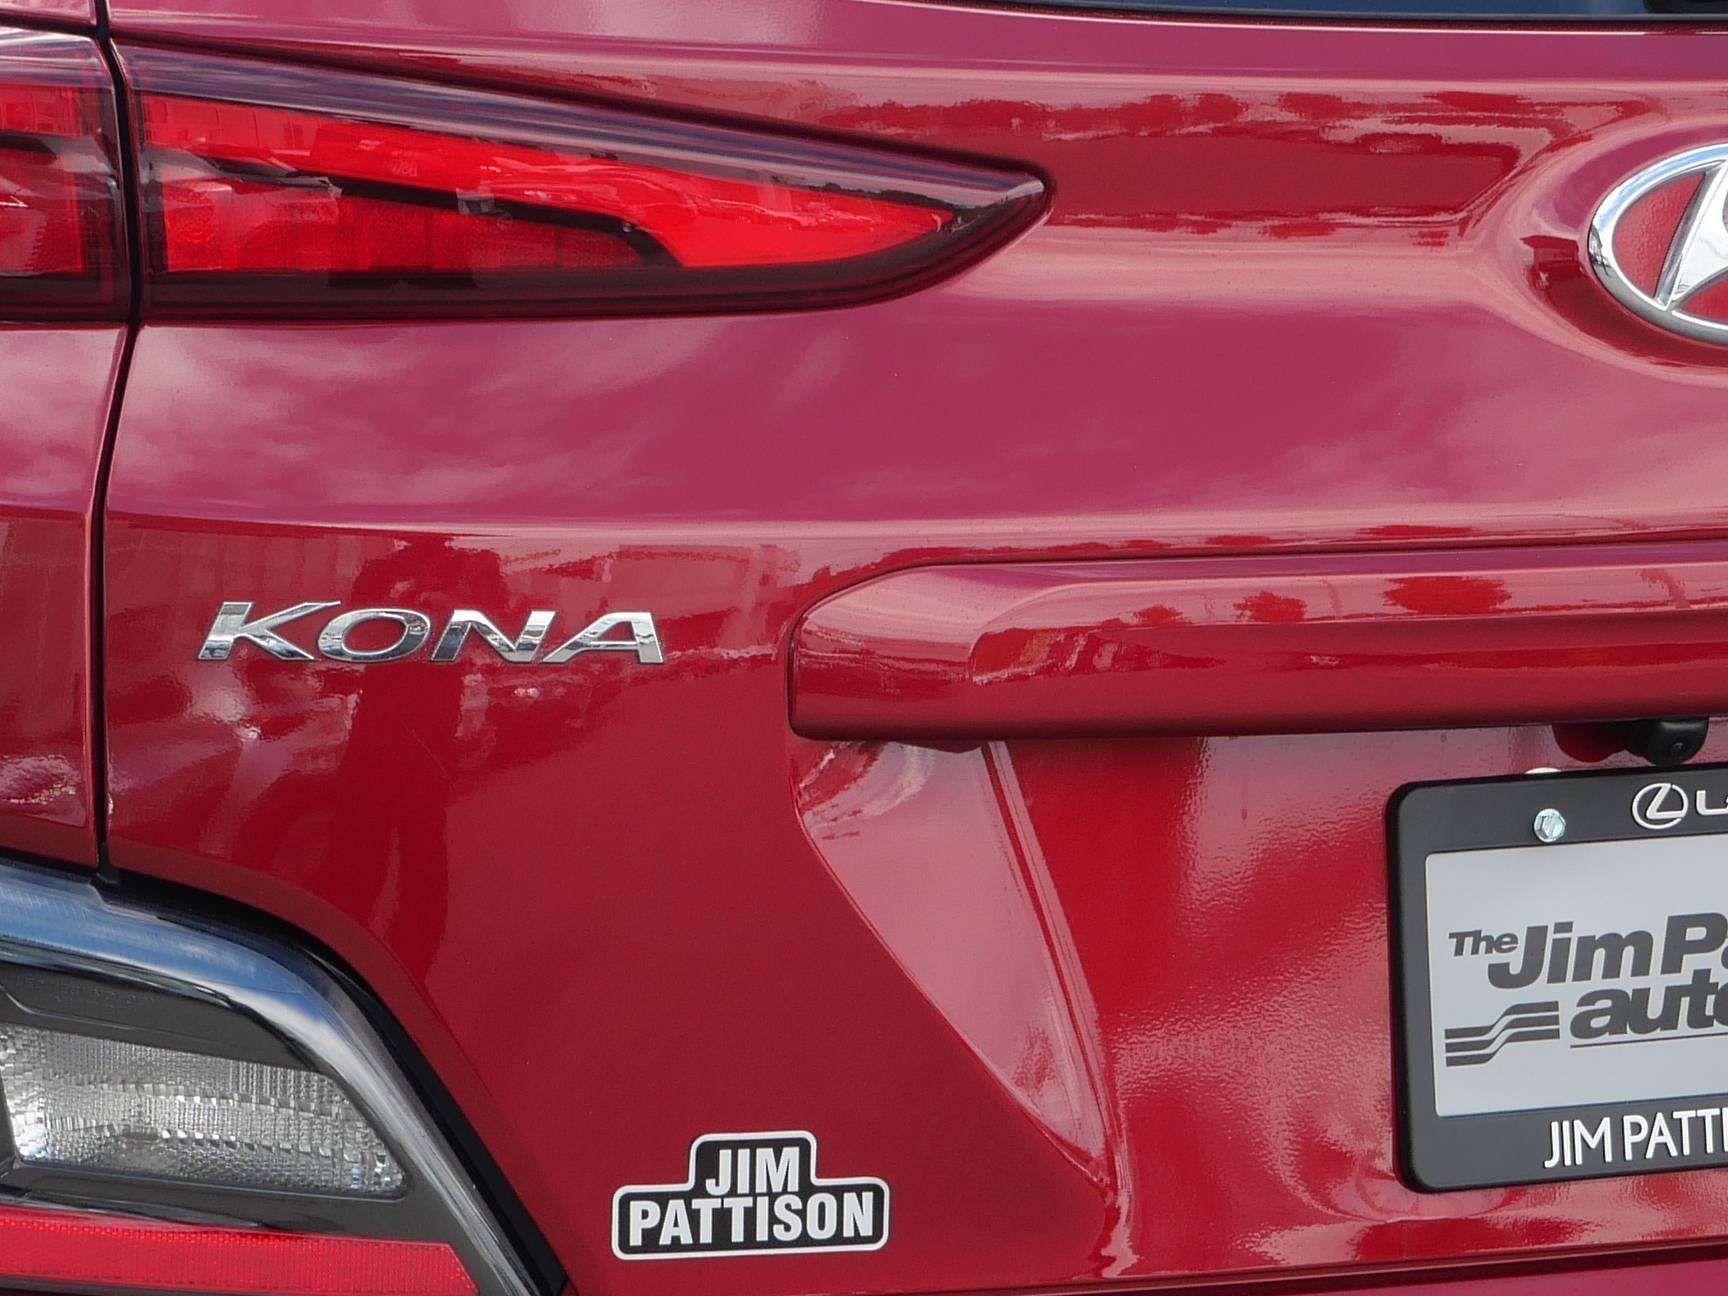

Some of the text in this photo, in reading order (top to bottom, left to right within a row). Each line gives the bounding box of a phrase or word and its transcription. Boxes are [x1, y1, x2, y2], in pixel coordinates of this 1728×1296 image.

[197, 600, 666, 665] KONA
[1448, 929, 1519, 958] The
[1487, 920, 1654, 990] Jim
[1542, 1115, 1614, 1169] JIM
[706, 1146, 801, 1198] JIM
[629, 1191, 874, 1248] PATTISON
